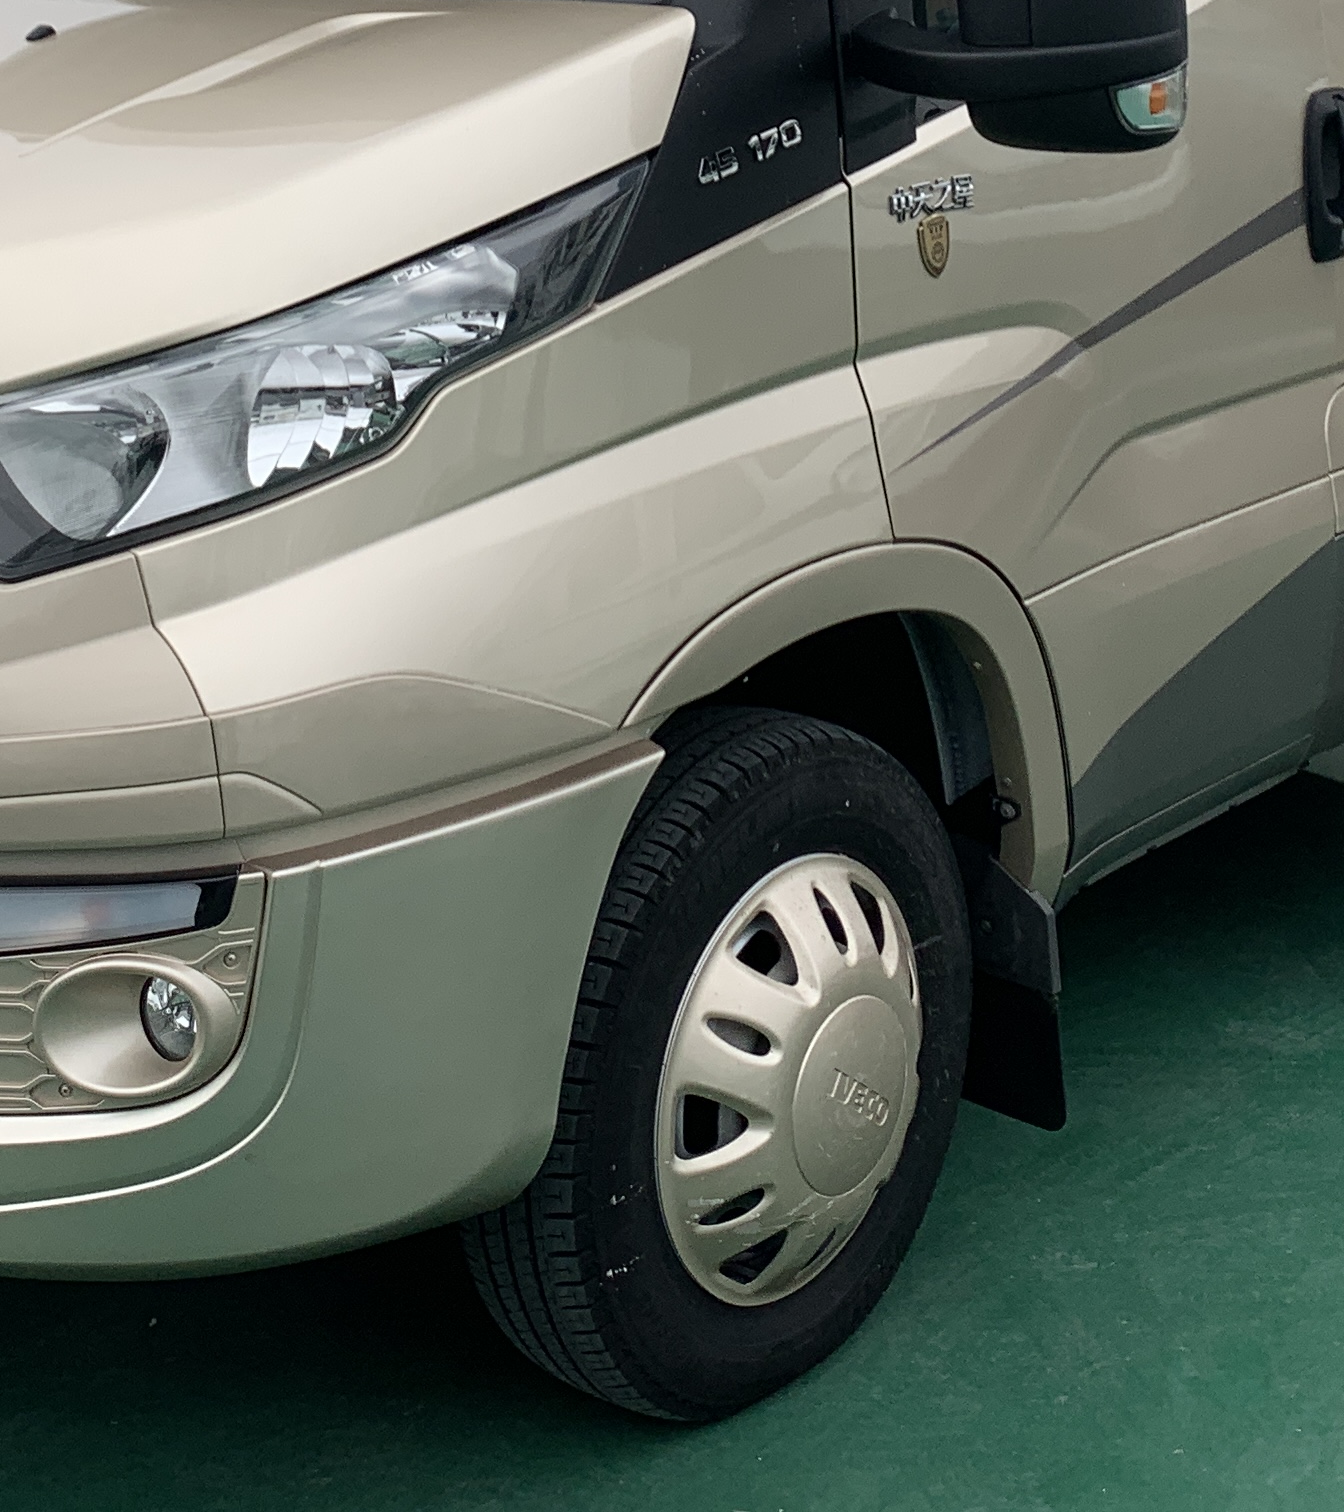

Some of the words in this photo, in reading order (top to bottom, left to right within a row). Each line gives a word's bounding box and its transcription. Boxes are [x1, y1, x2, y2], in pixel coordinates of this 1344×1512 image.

[697, 147, 739, 185] 45
[748, 118, 802, 162] 170
[888, 173, 975, 223] 中天之星
[826, 1067, 891, 1127] IVECO
